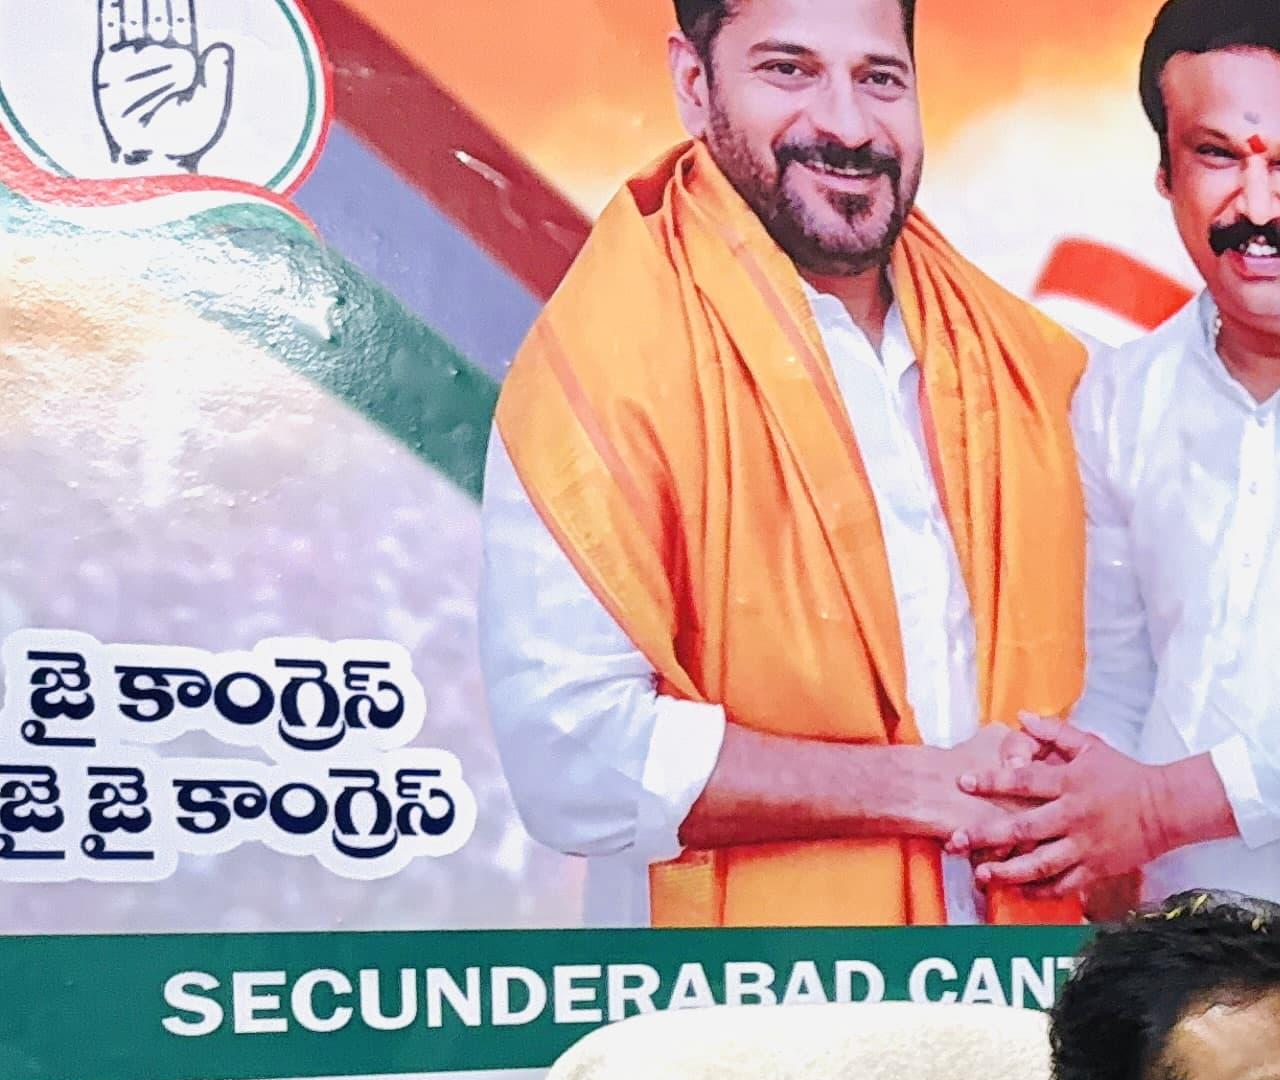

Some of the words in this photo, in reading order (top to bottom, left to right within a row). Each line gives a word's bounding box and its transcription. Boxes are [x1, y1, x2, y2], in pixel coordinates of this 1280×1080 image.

[21, 650, 96, 748] జై
[114, 658, 405, 751] కాంగ్రెస్
[81, 766, 154, 860] జై
[172, 768, 456, 859] కాంగ్రెస్
[161, 956, 886, 1037] SECUNDERABAD
